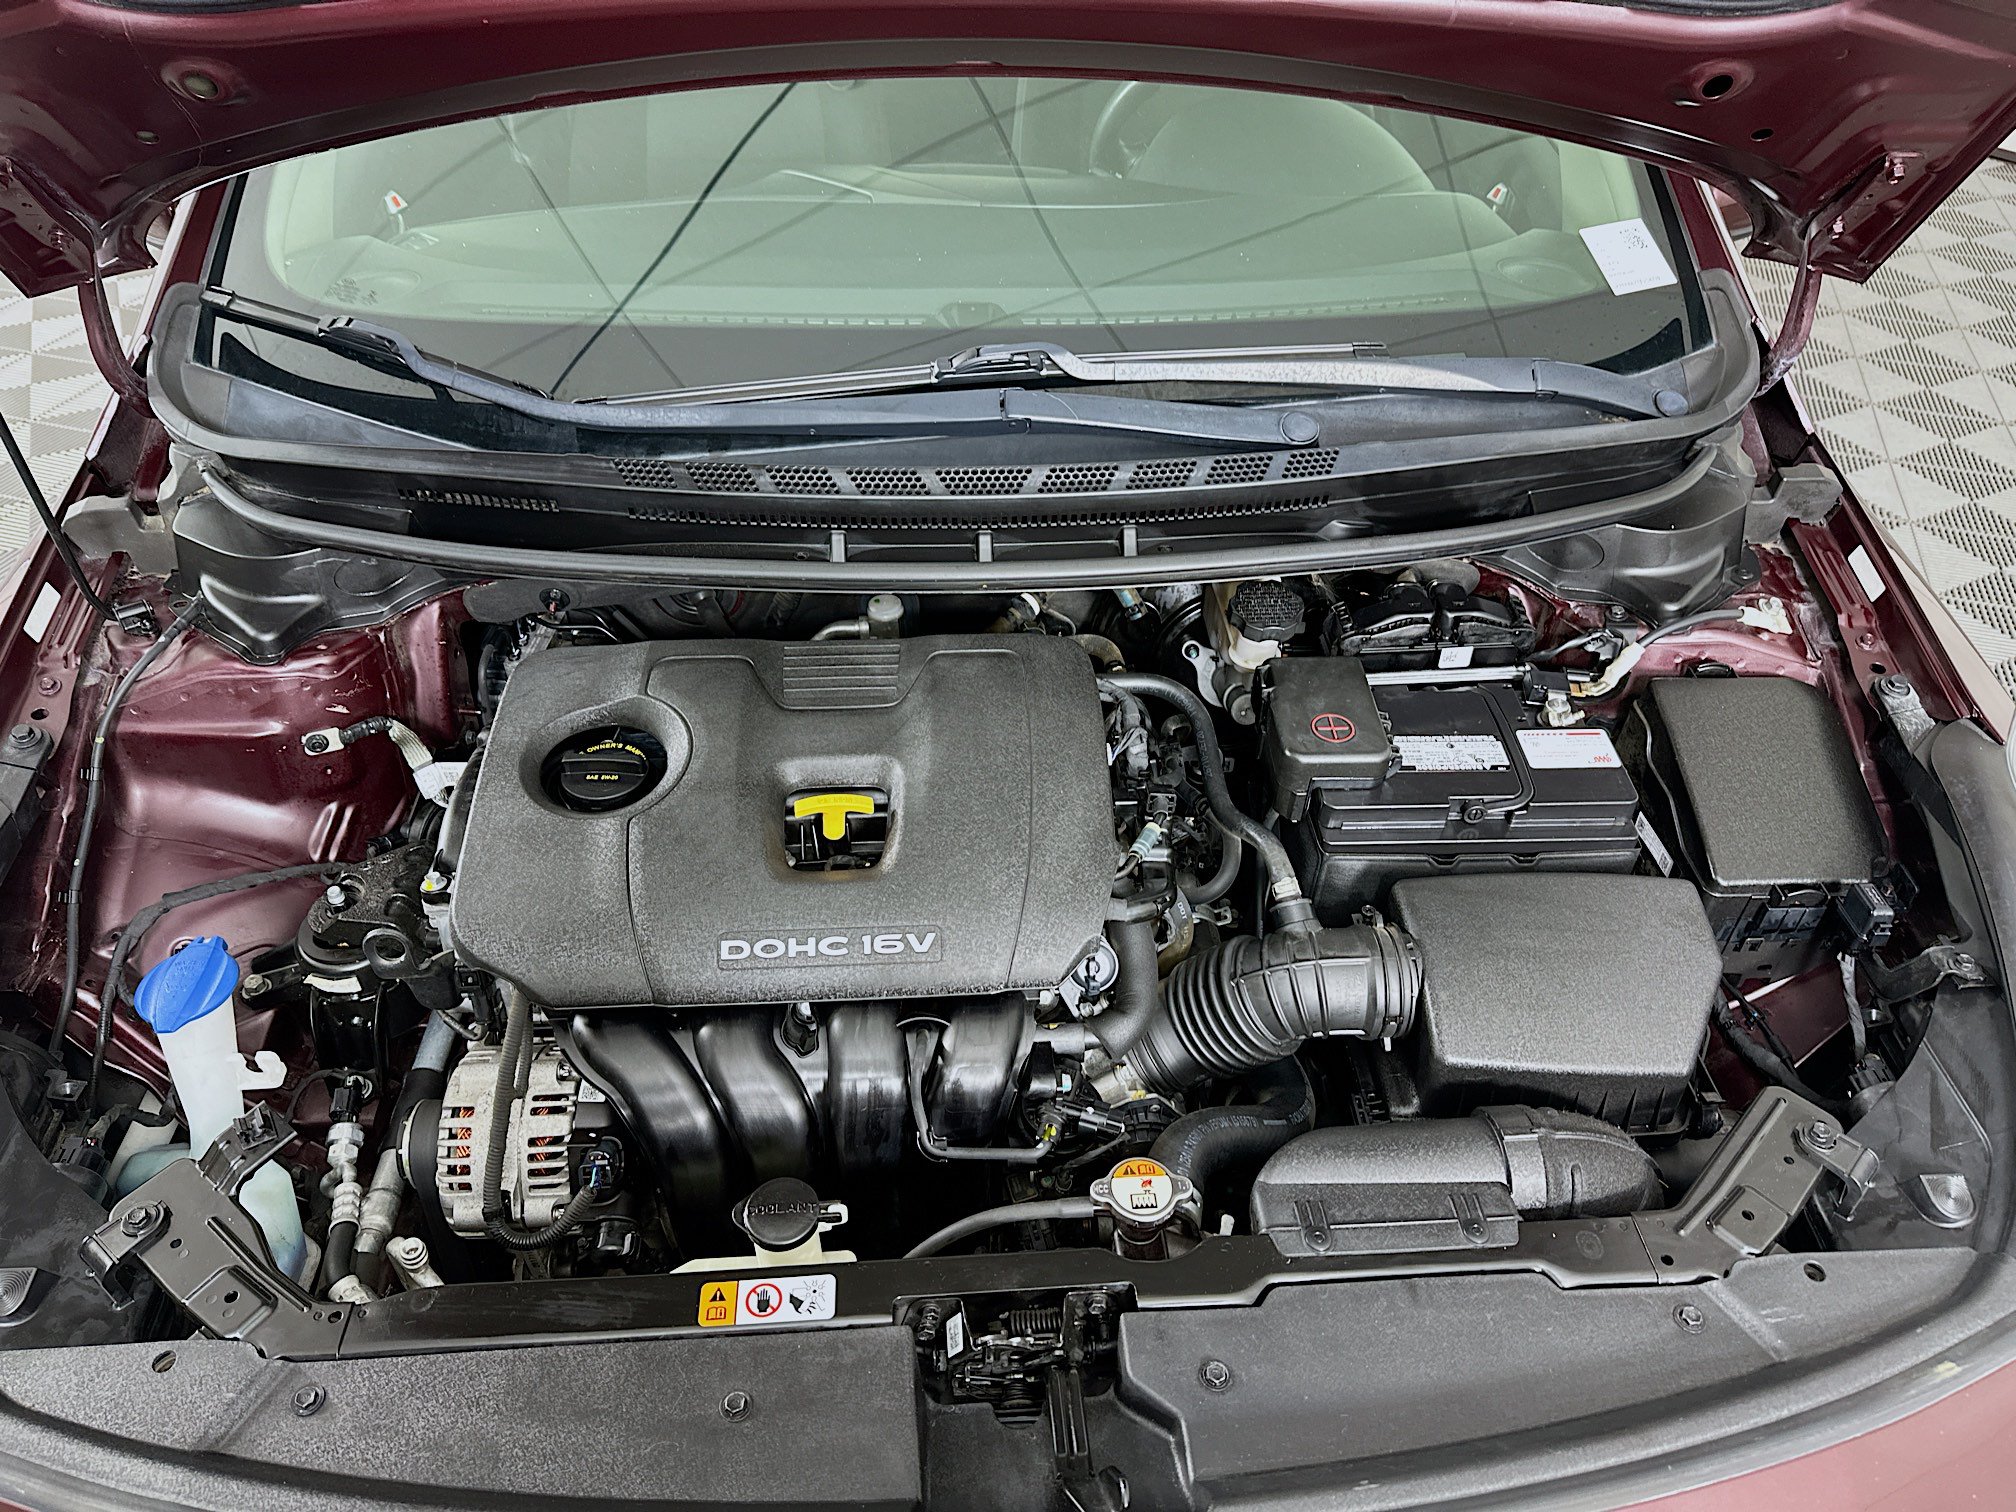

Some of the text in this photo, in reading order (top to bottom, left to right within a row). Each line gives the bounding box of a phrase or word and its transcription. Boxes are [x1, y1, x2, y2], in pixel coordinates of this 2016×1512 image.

[587, 742, 624, 753] OWNER'S
[720, 932, 937, 961] DOHC 16V
[749, 1202, 818, 1217] COOLANT
